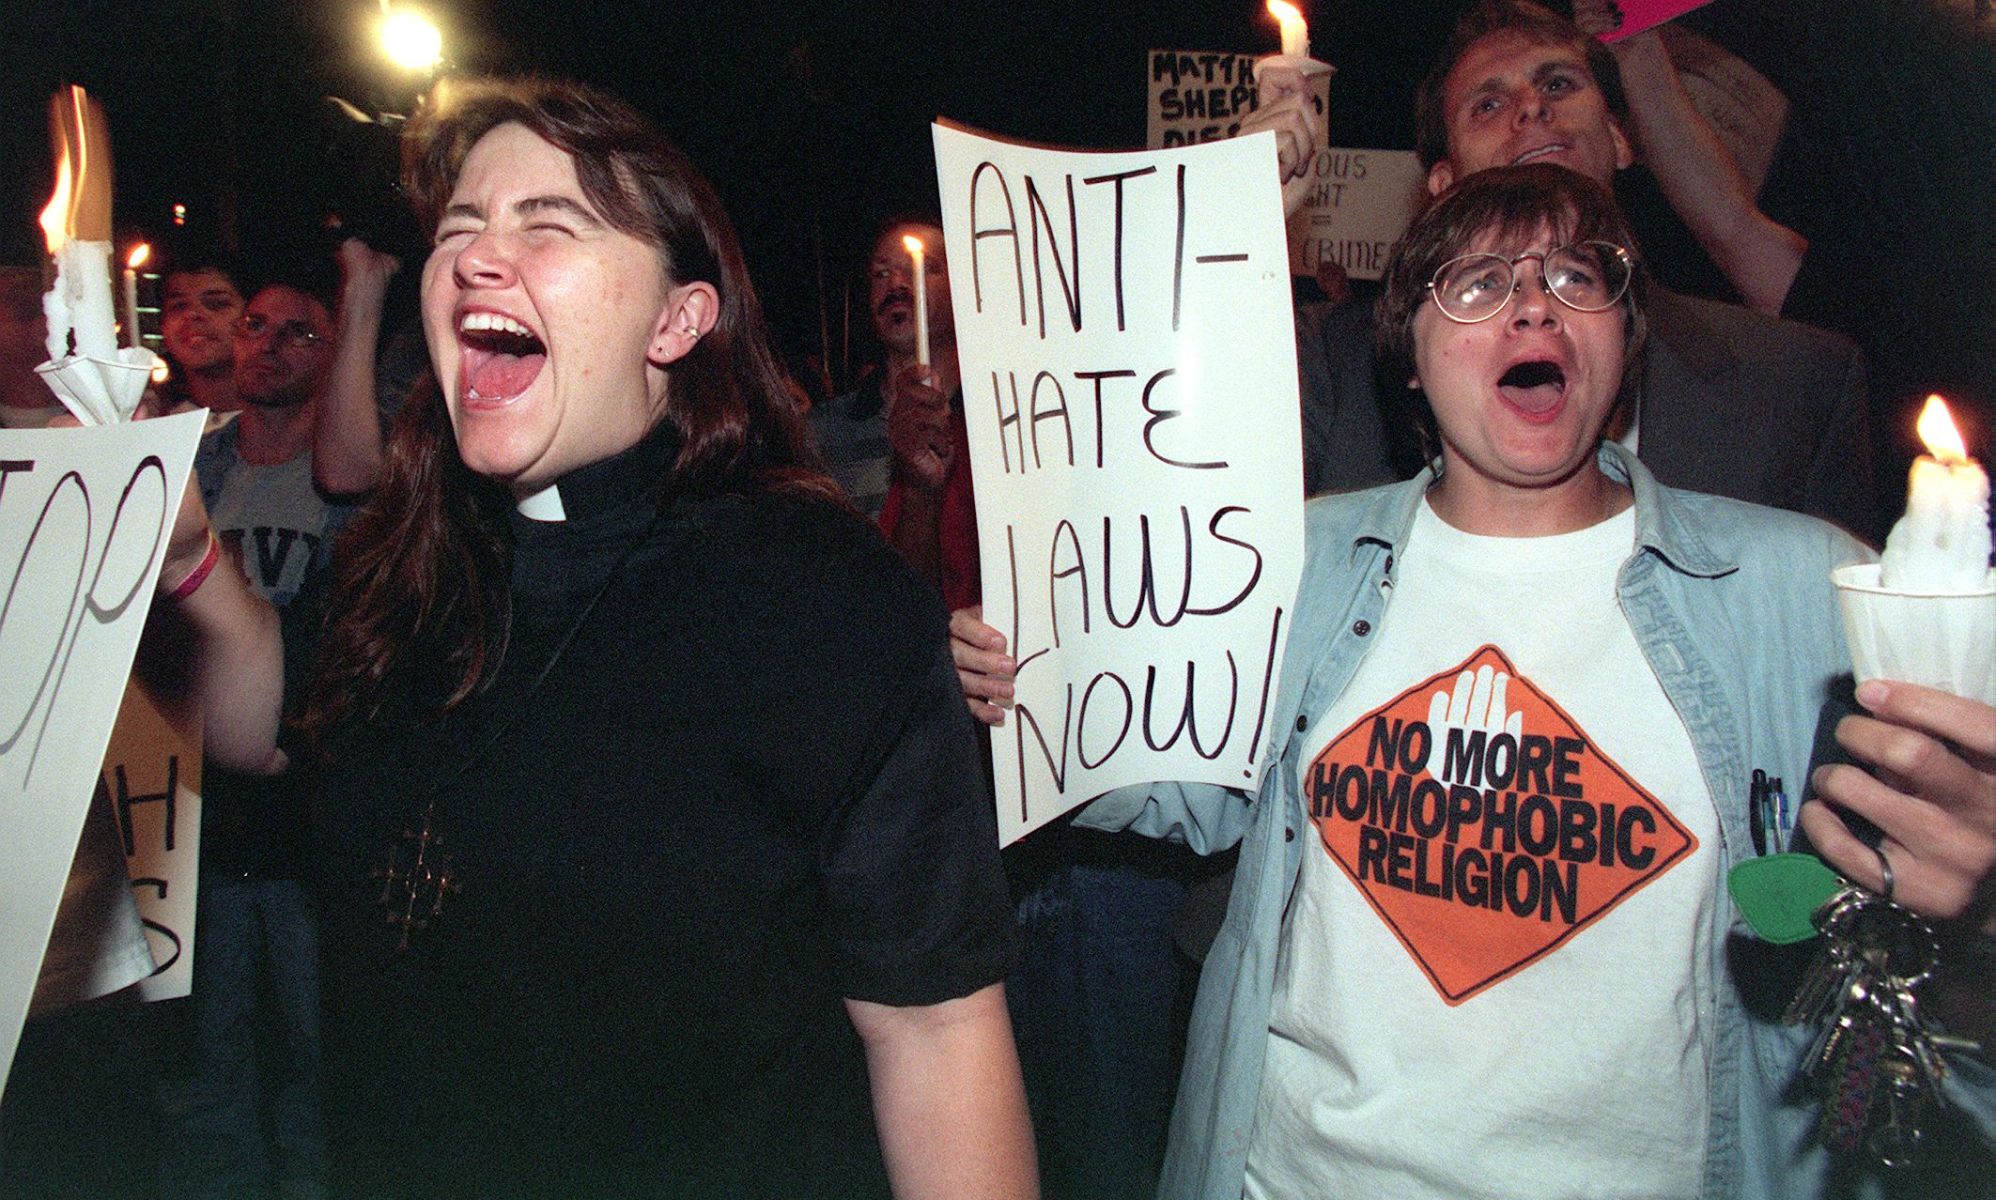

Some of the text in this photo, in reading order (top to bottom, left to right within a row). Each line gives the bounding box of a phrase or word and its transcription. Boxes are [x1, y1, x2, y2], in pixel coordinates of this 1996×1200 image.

[1153, 53, 1254, 86] MATTH
[1159, 84, 1262, 121] SHEP
[1315, 153, 1367, 179] OUS
[970, 161, 1249, 339] ANTI-
[992, 368, 1230, 475] HATE
[1006, 505, 1263, 678] LAWS
[1014, 606, 1283, 823] NOW!
[1366, 715, 1586, 799] NO MORE
[1312, 762, 1657, 871] HOMOPHOBIC
[1358, 824, 1578, 926] RELIGION
